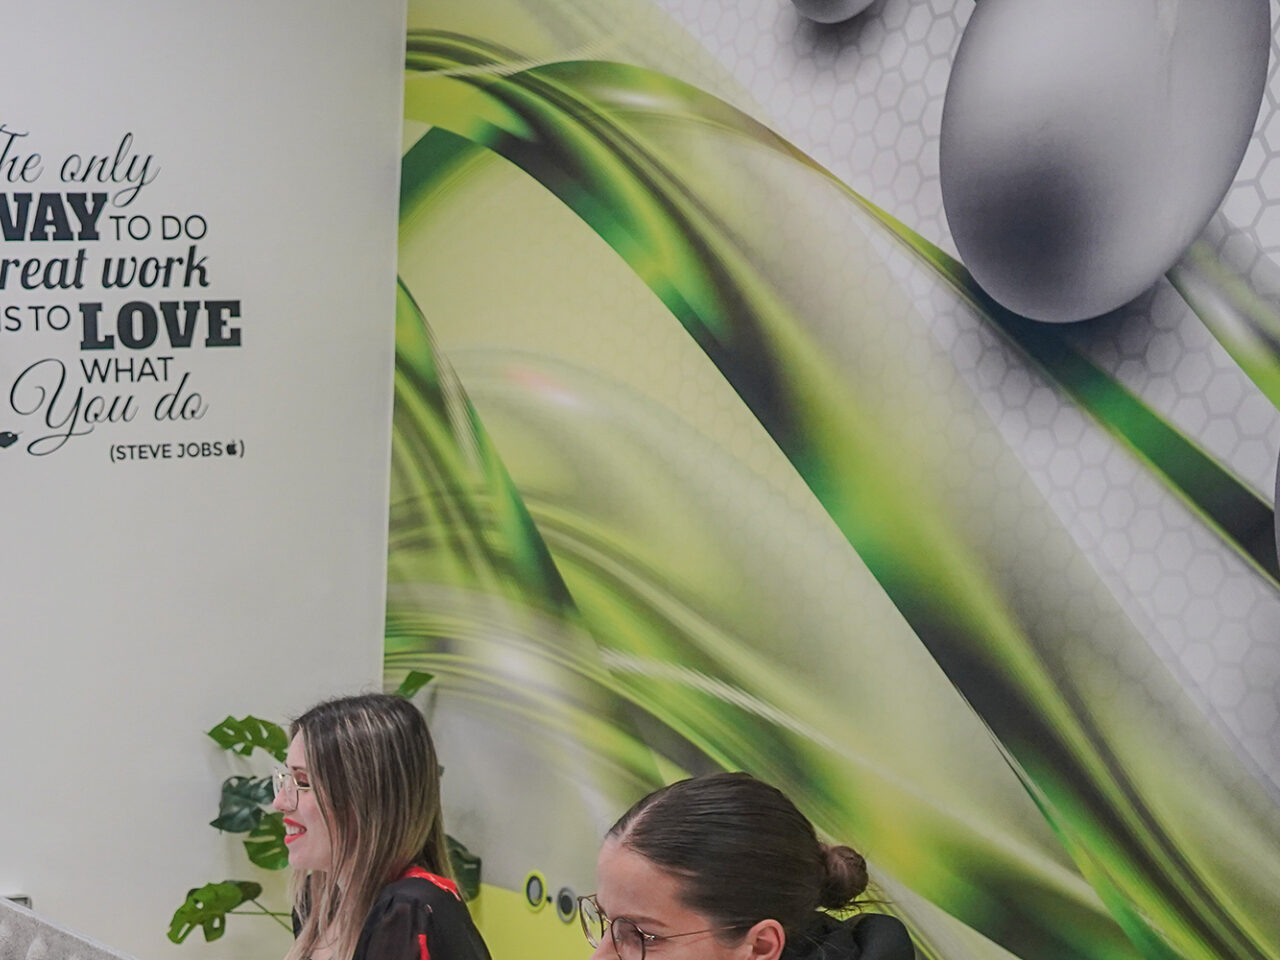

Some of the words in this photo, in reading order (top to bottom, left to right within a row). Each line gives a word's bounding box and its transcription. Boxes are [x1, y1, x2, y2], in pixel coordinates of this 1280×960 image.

[59, 132, 161, 209] only
[108, 214, 152, 242] TO
[160, 213, 209, 241] DO
[100, 244, 211, 290] work
[26, 304, 72, 332] TO
[78, 298, 243, 352] LOVE
[79, 356, 175, 385] WHAT
[9, 357, 139, 457] You
[153, 371, 209, 424] do
[109, 442, 173, 465] (STEVE
